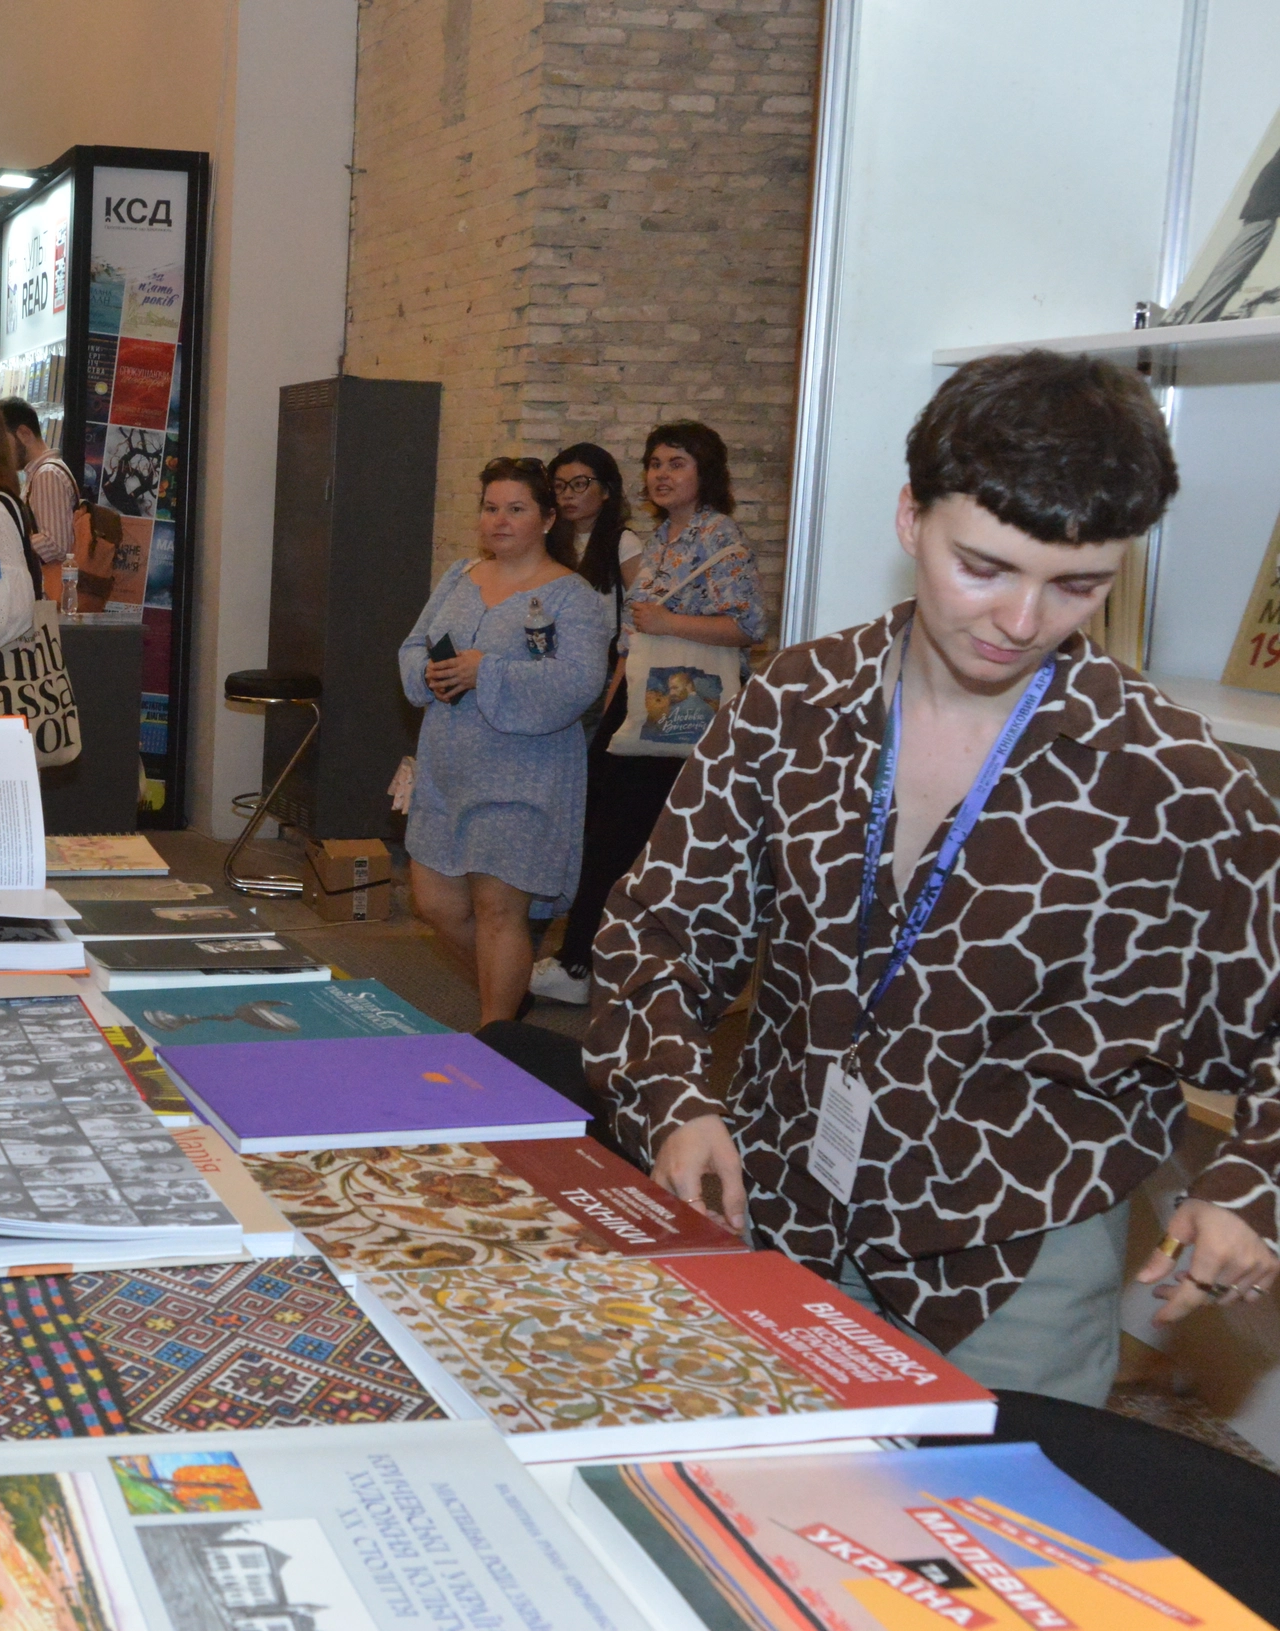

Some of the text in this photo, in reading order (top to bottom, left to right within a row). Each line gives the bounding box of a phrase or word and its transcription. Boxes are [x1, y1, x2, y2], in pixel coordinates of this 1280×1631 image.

[104, 196, 173, 227] КСД
[21, 271, 49, 320] READ
[35, 708, 77, 754] or
[996, 693, 1038, 756] КНИЖКОВИЙ
[559, 1186, 658, 1245] ТЕХНІКИ
[801, 1301, 940, 1387] ВИШИВКА
[345, 1469, 420, 1560] ХУДОЖНЯ
[367, 1452, 452, 1553] КРИЧЕВСЬКІ
[806, 1527, 974, 1628] УКРАЇНА
[912, 1509, 1068, 1629] МАЛЕВИЧ
